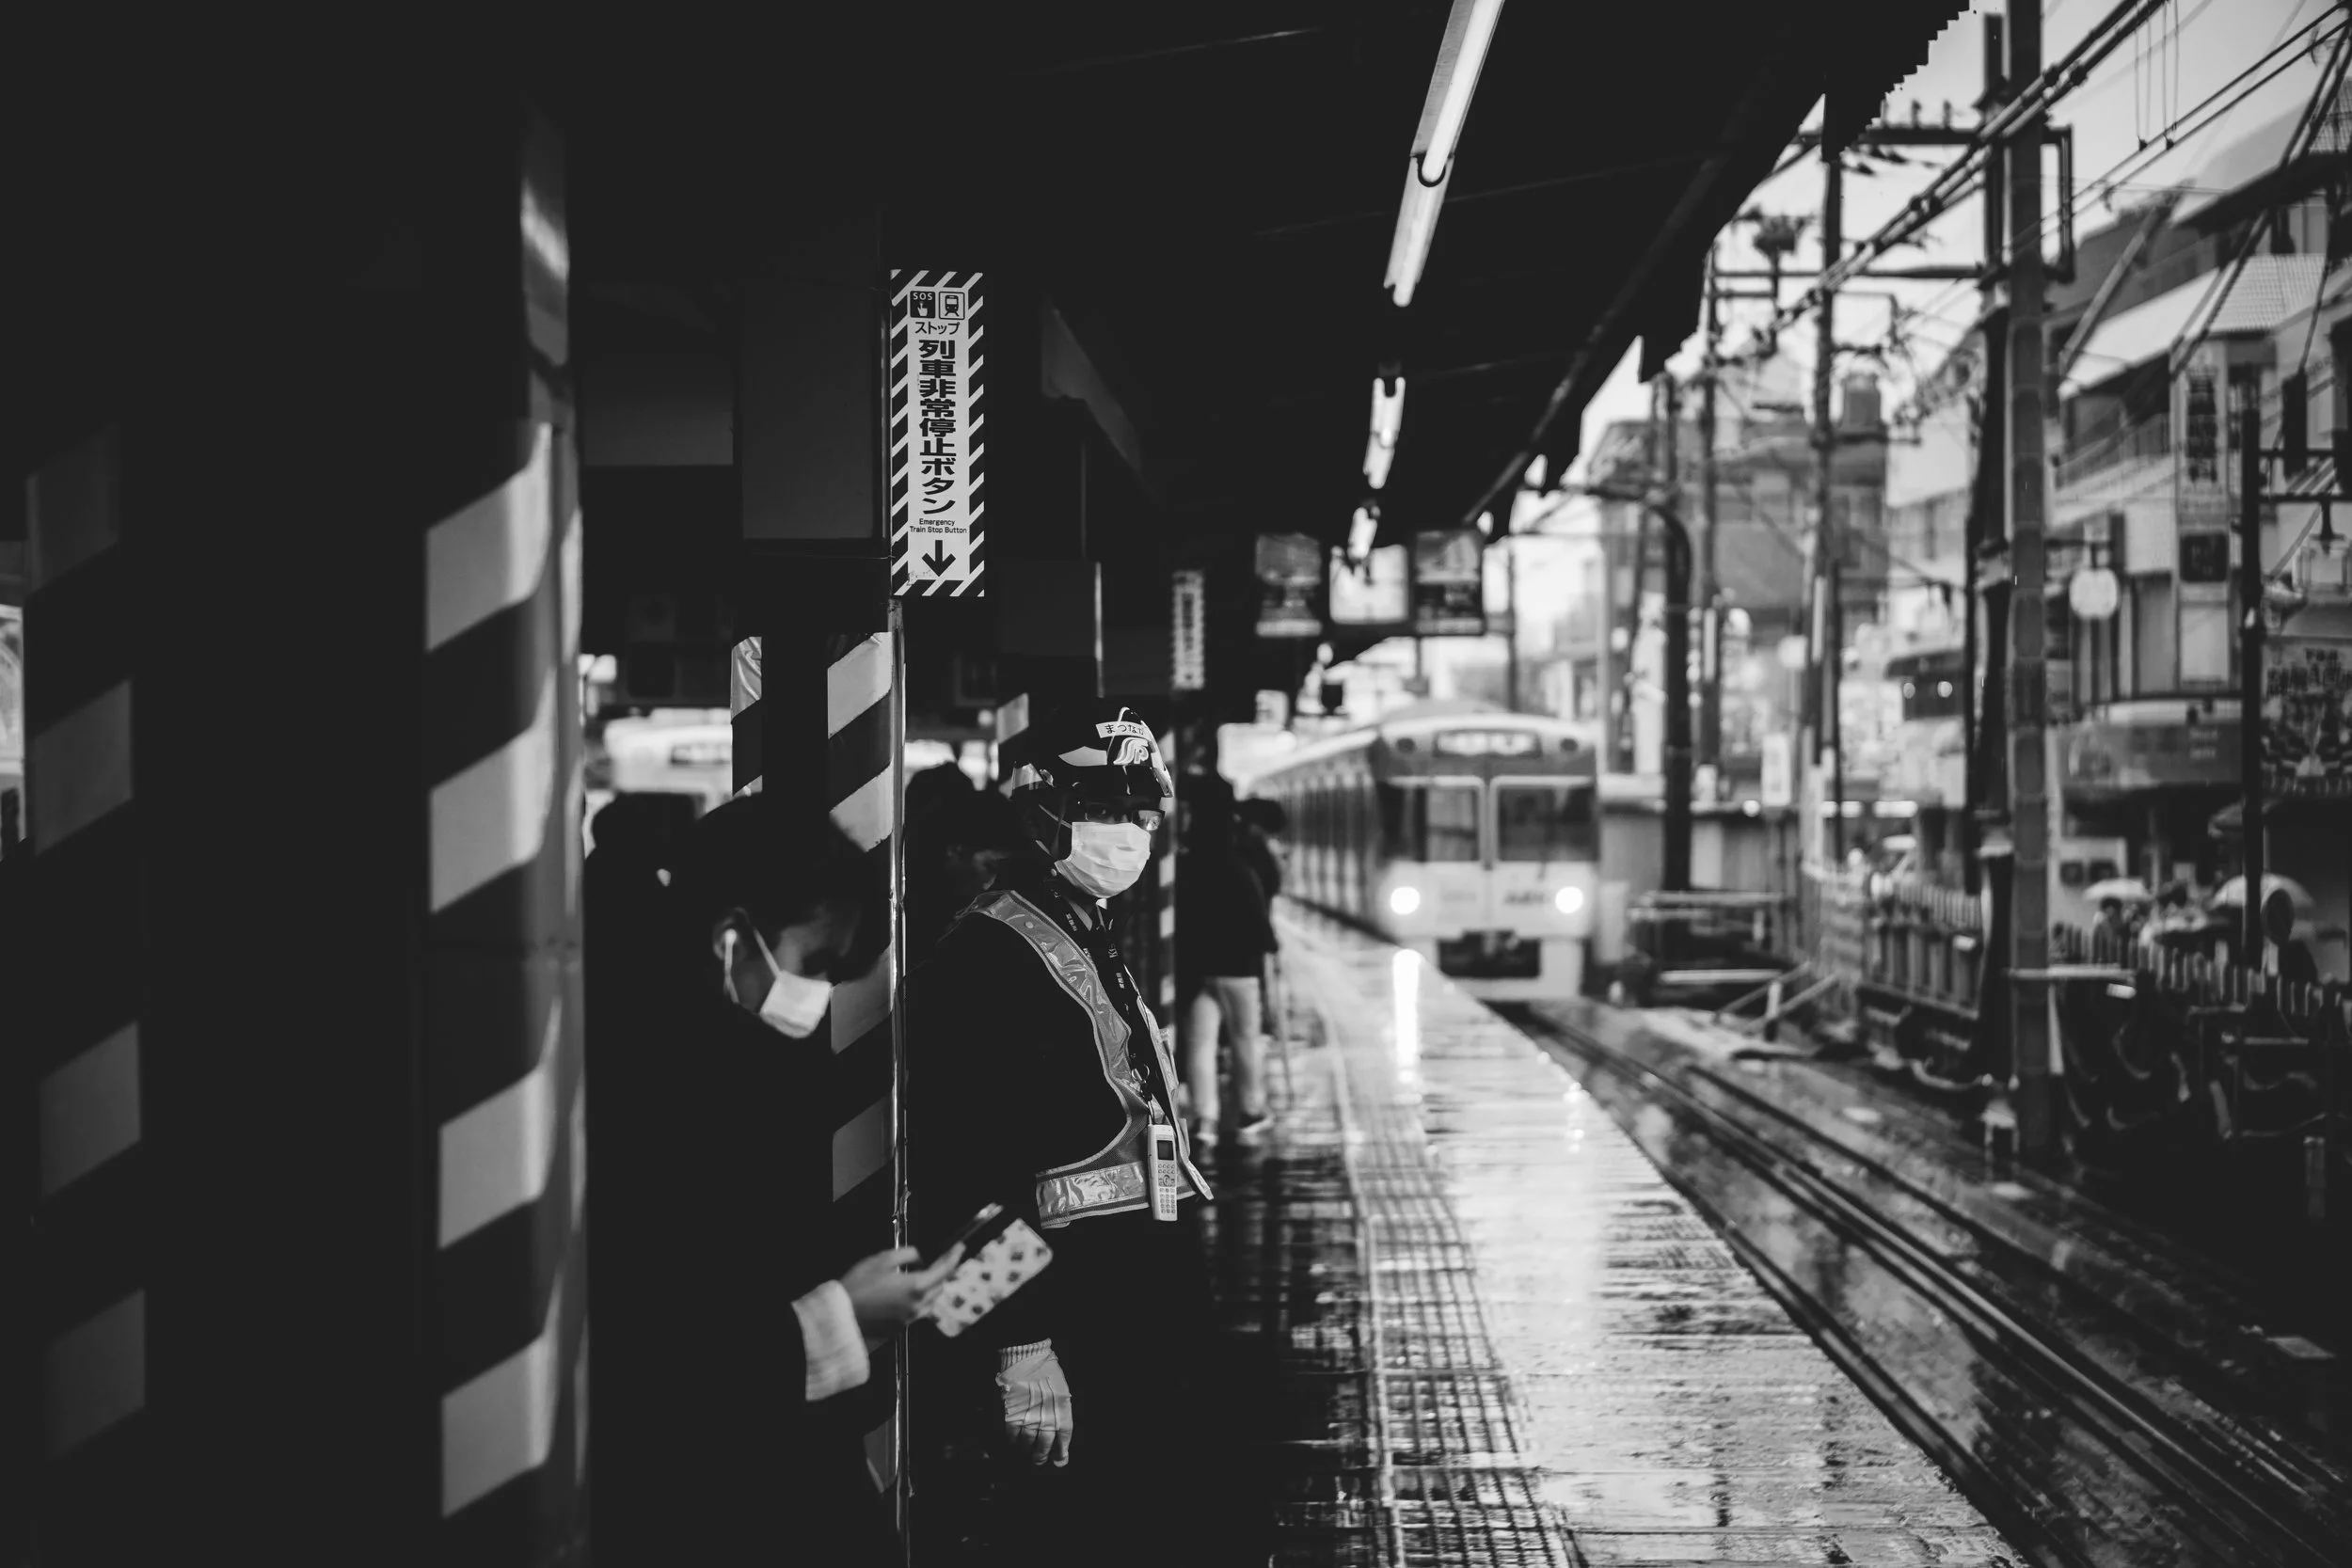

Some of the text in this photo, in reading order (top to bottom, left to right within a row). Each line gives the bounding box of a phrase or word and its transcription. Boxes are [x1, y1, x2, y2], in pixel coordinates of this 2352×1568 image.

[913, 292, 933, 301] SOS
[914, 321, 961, 335] ストップ
[918, 340, 957, 515] 列車非常停止ボタン
[919, 517, 956, 526] Emergency
[928, 526, 943, 534] Stop
[945, 526, 967, 534] Button
